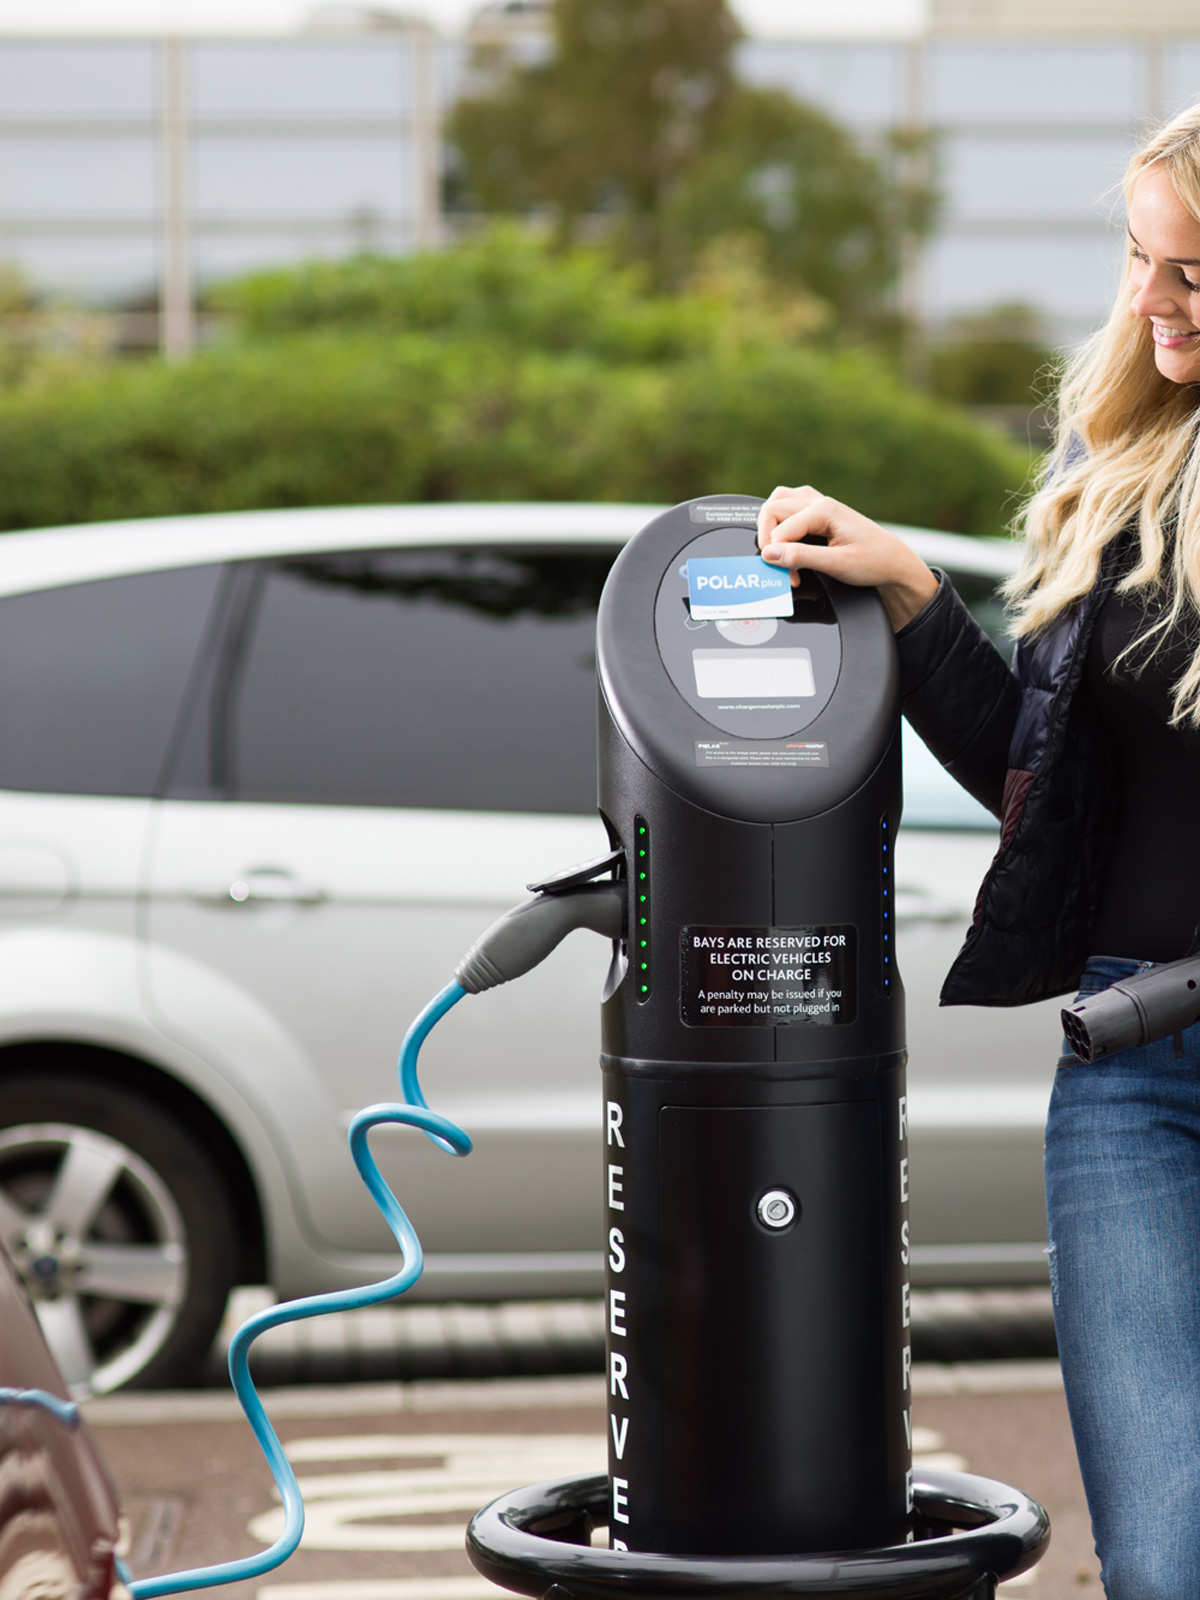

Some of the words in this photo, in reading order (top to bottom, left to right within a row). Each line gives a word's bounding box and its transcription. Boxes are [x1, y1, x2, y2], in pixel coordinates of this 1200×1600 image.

[696, 574, 760, 590] POLAR
[761, 578, 782, 589] plus
[693, 936, 725, 948] BAYS
[727, 936, 753, 948] ARE
[756, 936, 821, 948] RESERVED
[823, 935, 846, 947] FOR
[710, 953, 770, 965] ELECTRIC
[772, 952, 832, 964] VEHICLES
[732, 969, 754, 981] ON
[757, 969, 811, 981] CHARGE
[698, 990, 706, 999] A
[707, 989, 745, 1002] penalty
[747, 991, 769, 1002] may
[771, 989, 784, 999] be
[786, 988, 816, 999] issued
[817, 988, 824, 998] if
[825, 990, 842, 1001] you
[700, 1005, 716, 1014] are
[717, 1003, 751, 1016] parked
[754, 1003, 771, 1014] but
[773, 1004, 791, 1014] not
[792, 1003, 830, 1016] plugged
[832, 1003, 840, 1012] in
[606, 1100, 629, 1552] RESERVE
[899, 1095, 914, 1544] RESERVE
